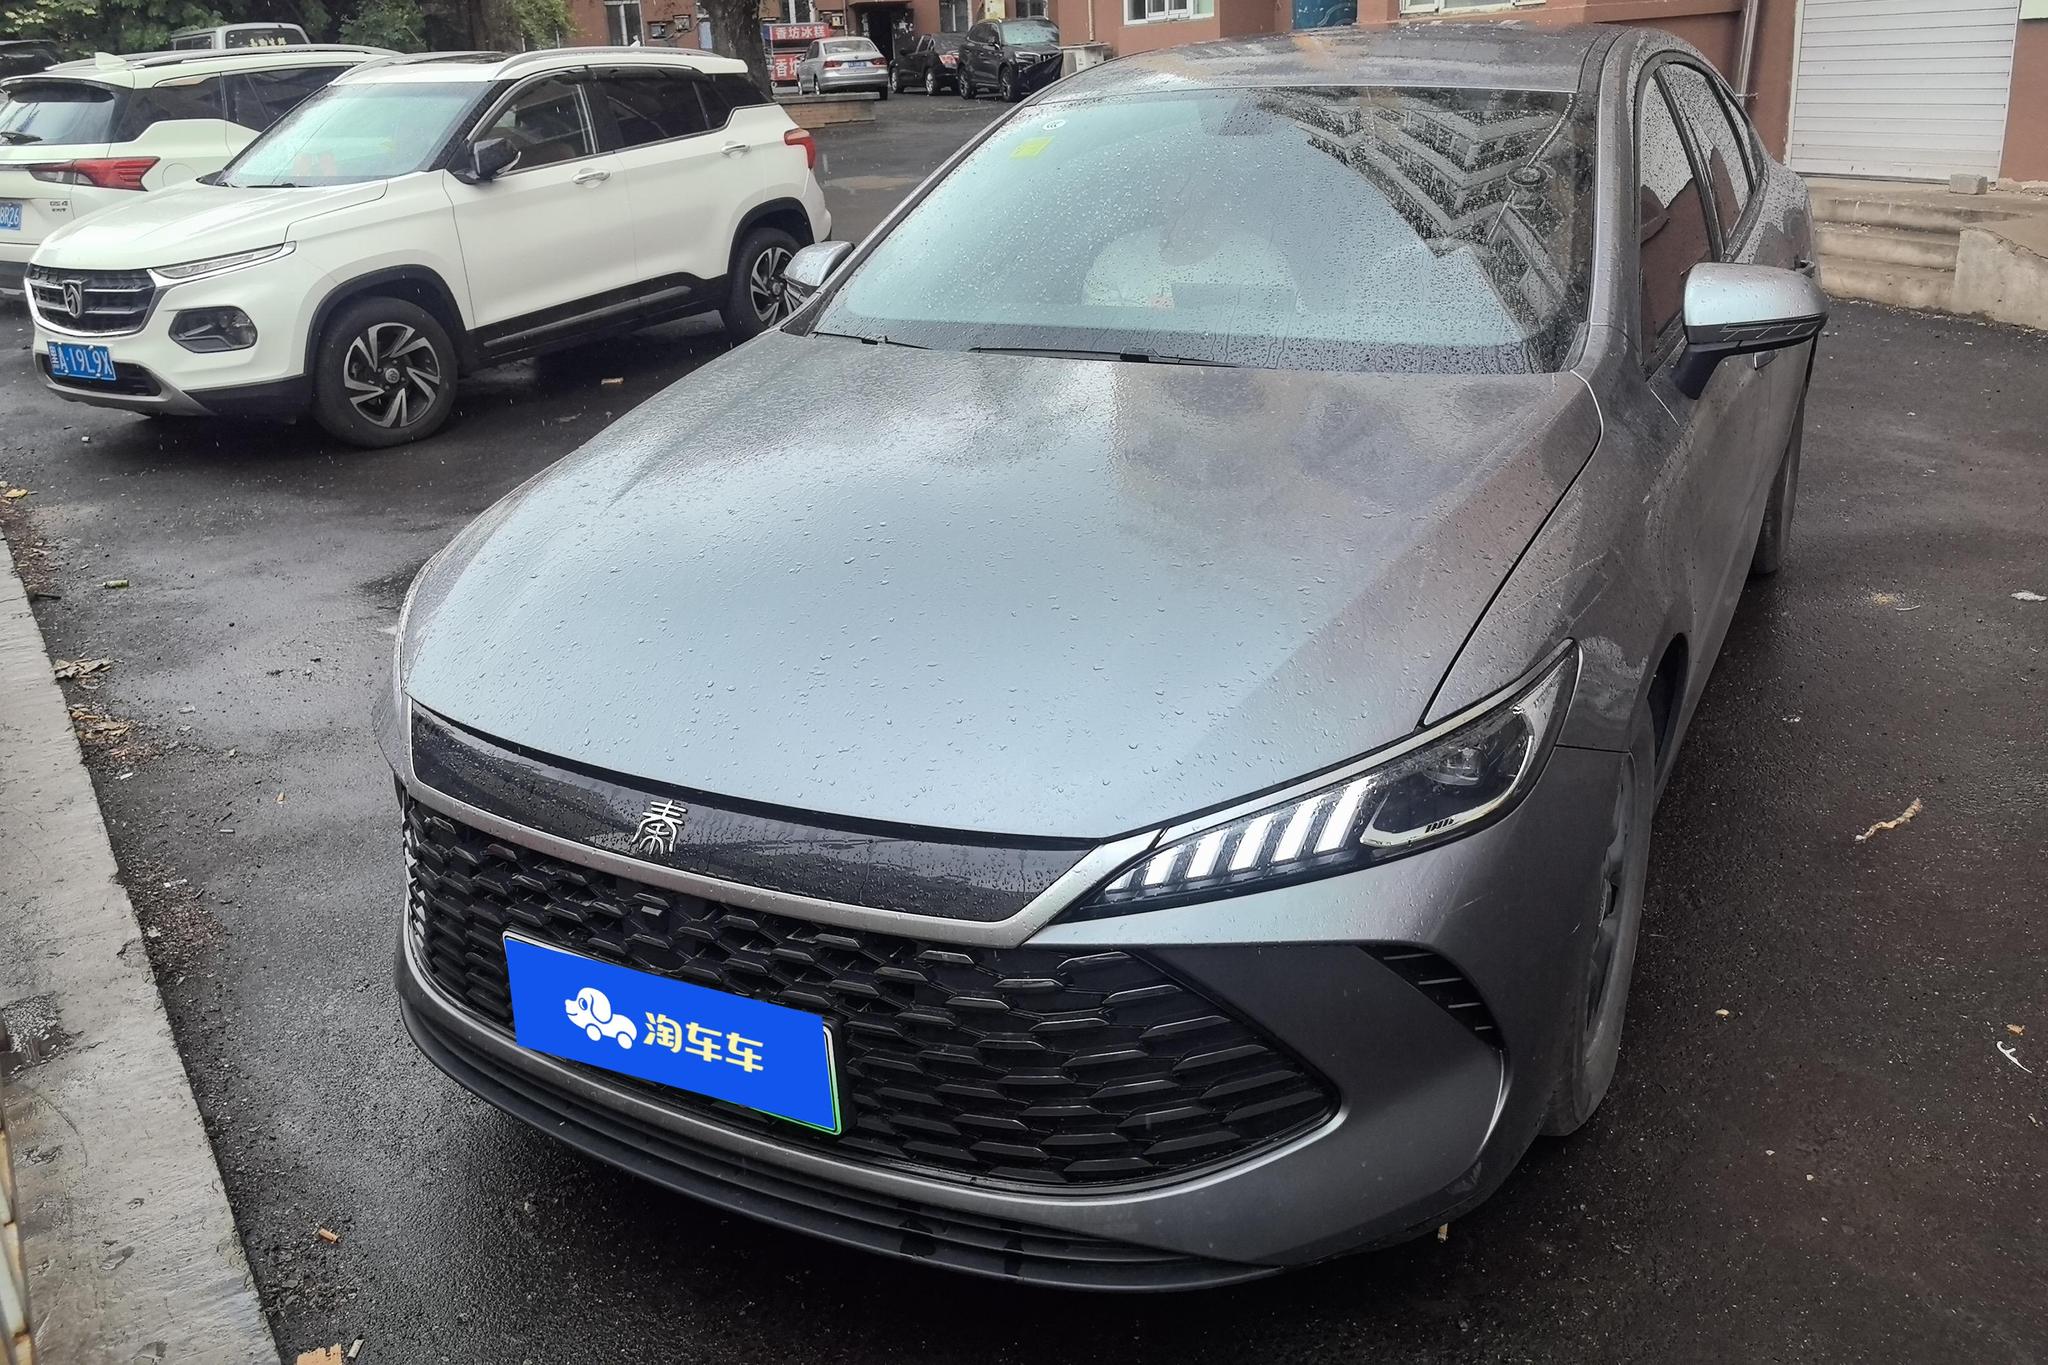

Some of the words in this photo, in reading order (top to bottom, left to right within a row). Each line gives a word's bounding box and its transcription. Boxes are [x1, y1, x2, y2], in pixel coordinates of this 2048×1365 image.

[775, 26, 826, 40] 香坊冰糕
[631, 799, 687, 855] 秦
